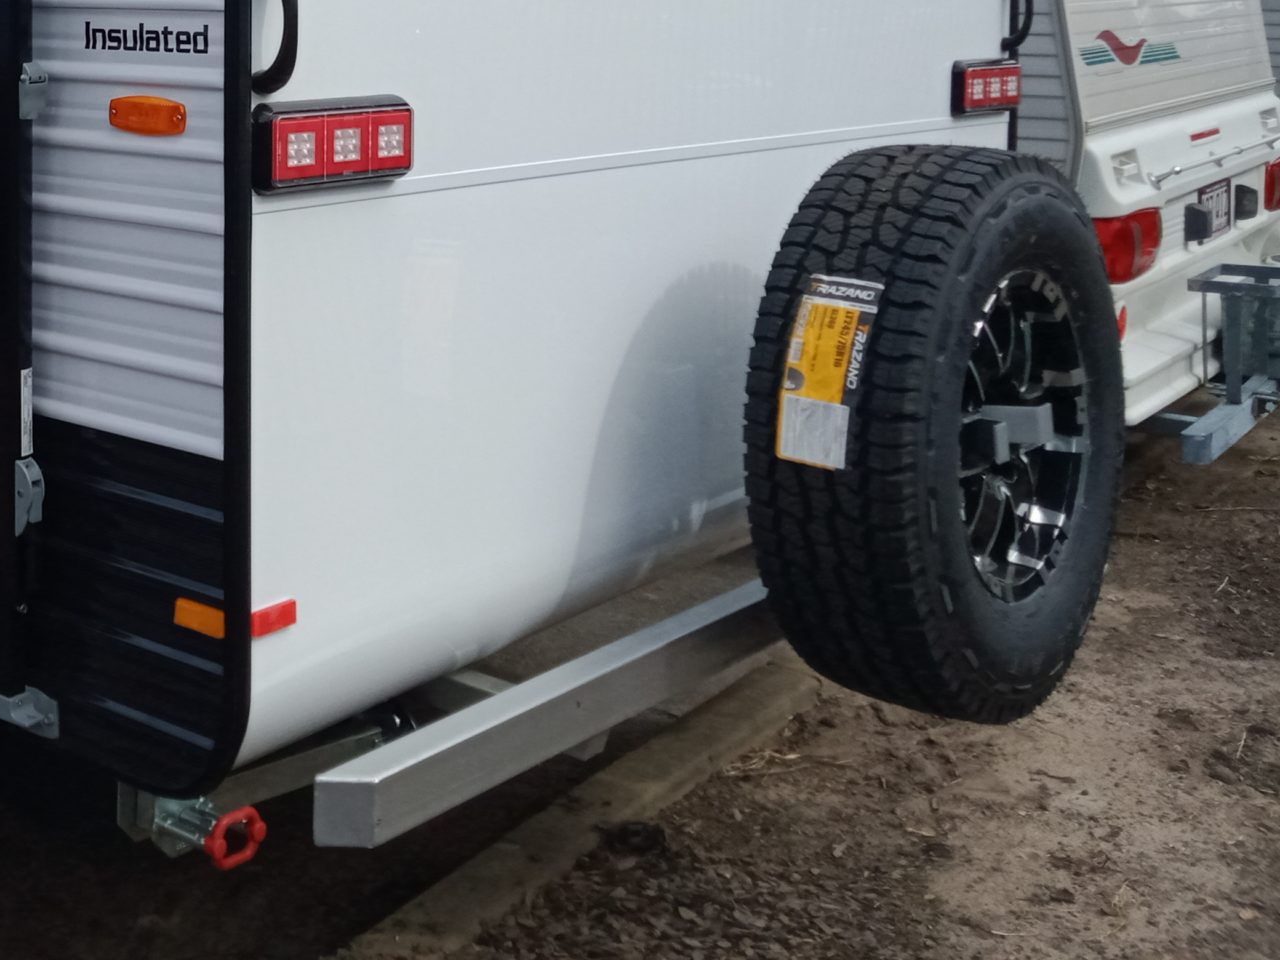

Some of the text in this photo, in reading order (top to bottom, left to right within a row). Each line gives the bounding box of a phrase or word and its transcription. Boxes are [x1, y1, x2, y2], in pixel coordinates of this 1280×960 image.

[84, 21, 209, 54] Insulated
[810, 282, 875, 300] TRAZANO
[846, 325, 868, 389] TRAZANO
